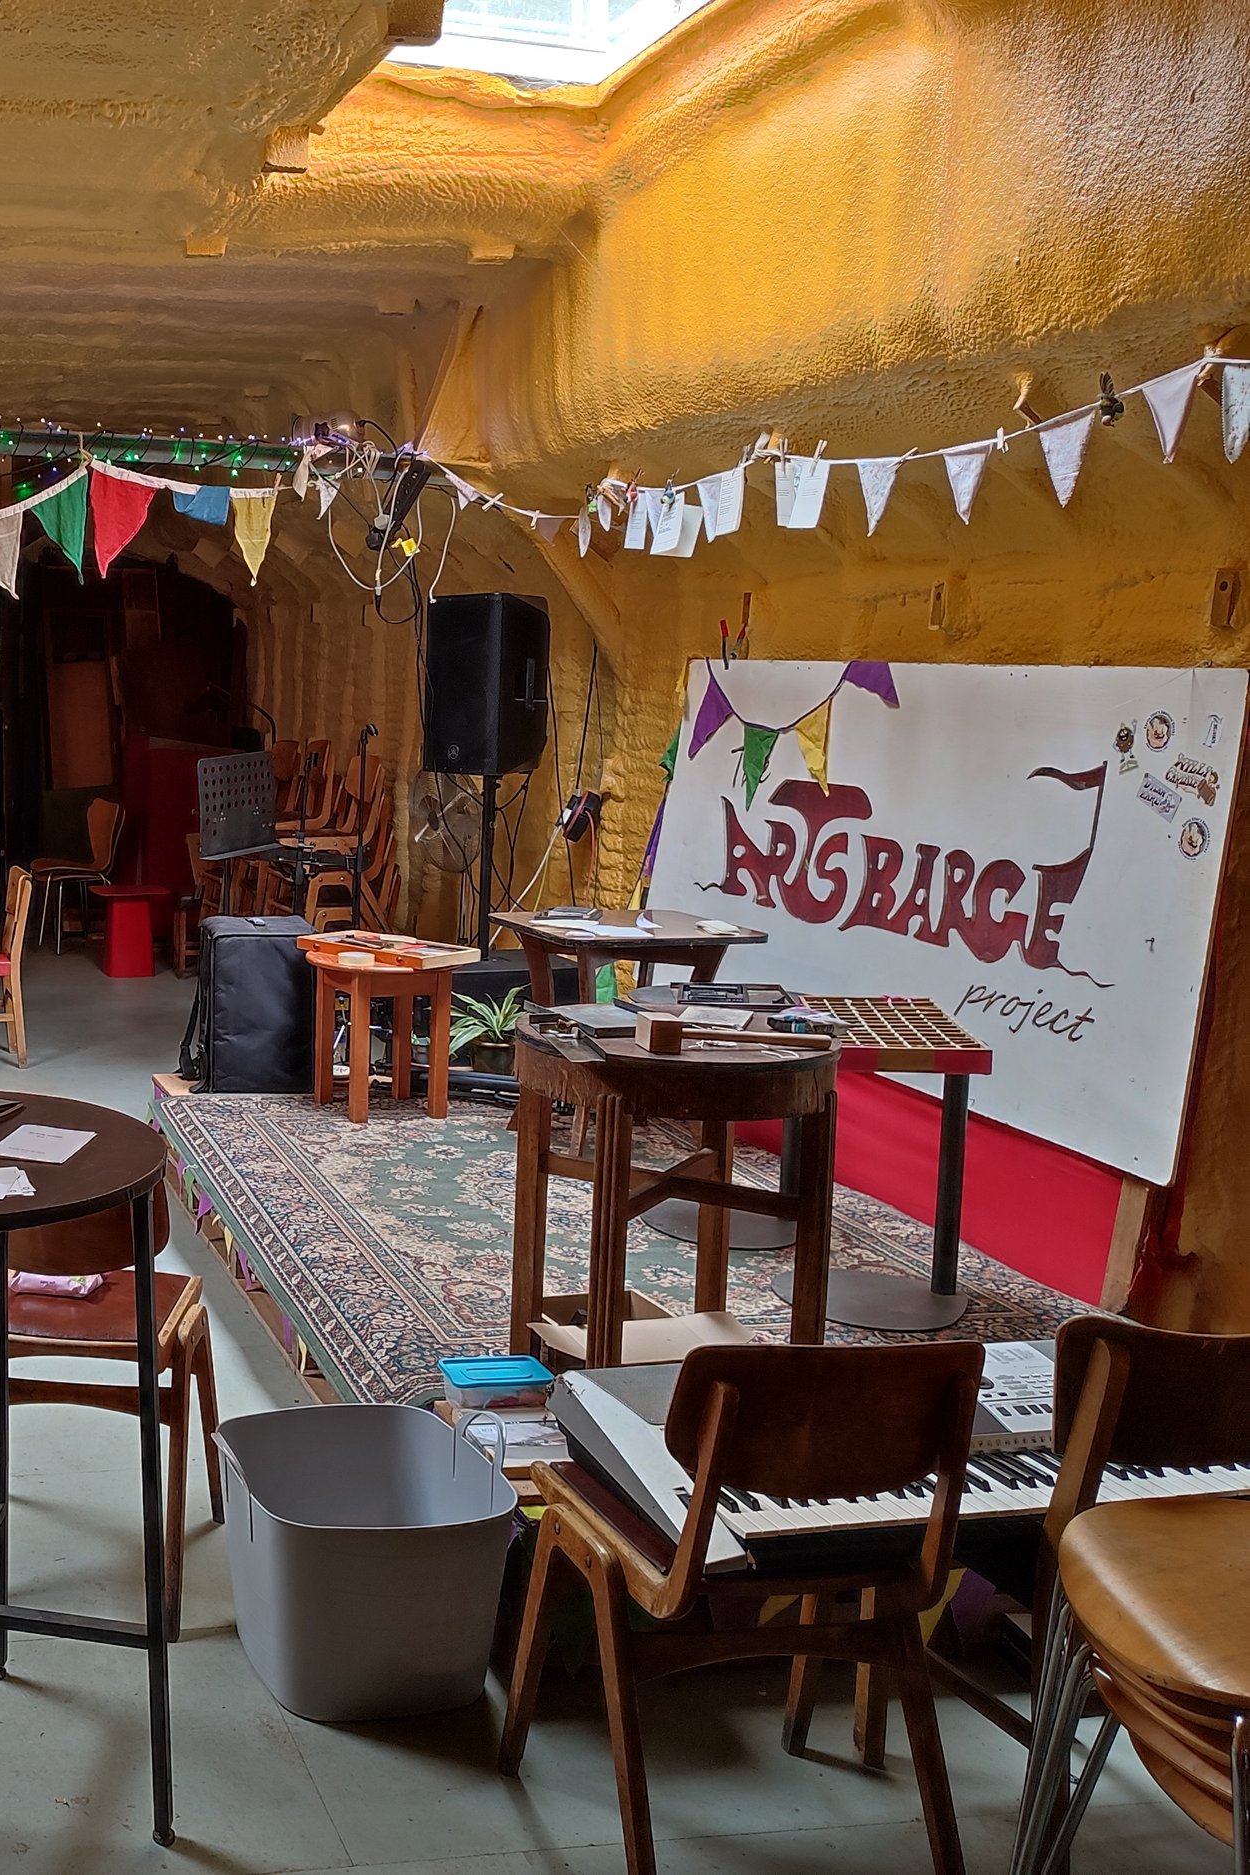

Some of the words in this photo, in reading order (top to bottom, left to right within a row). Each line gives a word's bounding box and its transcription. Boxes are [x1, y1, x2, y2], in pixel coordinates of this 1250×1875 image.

[721, 779, 873, 924] ARTS
[838, 834, 1093, 969] BARGE
[953, 984, 1095, 1042] project
